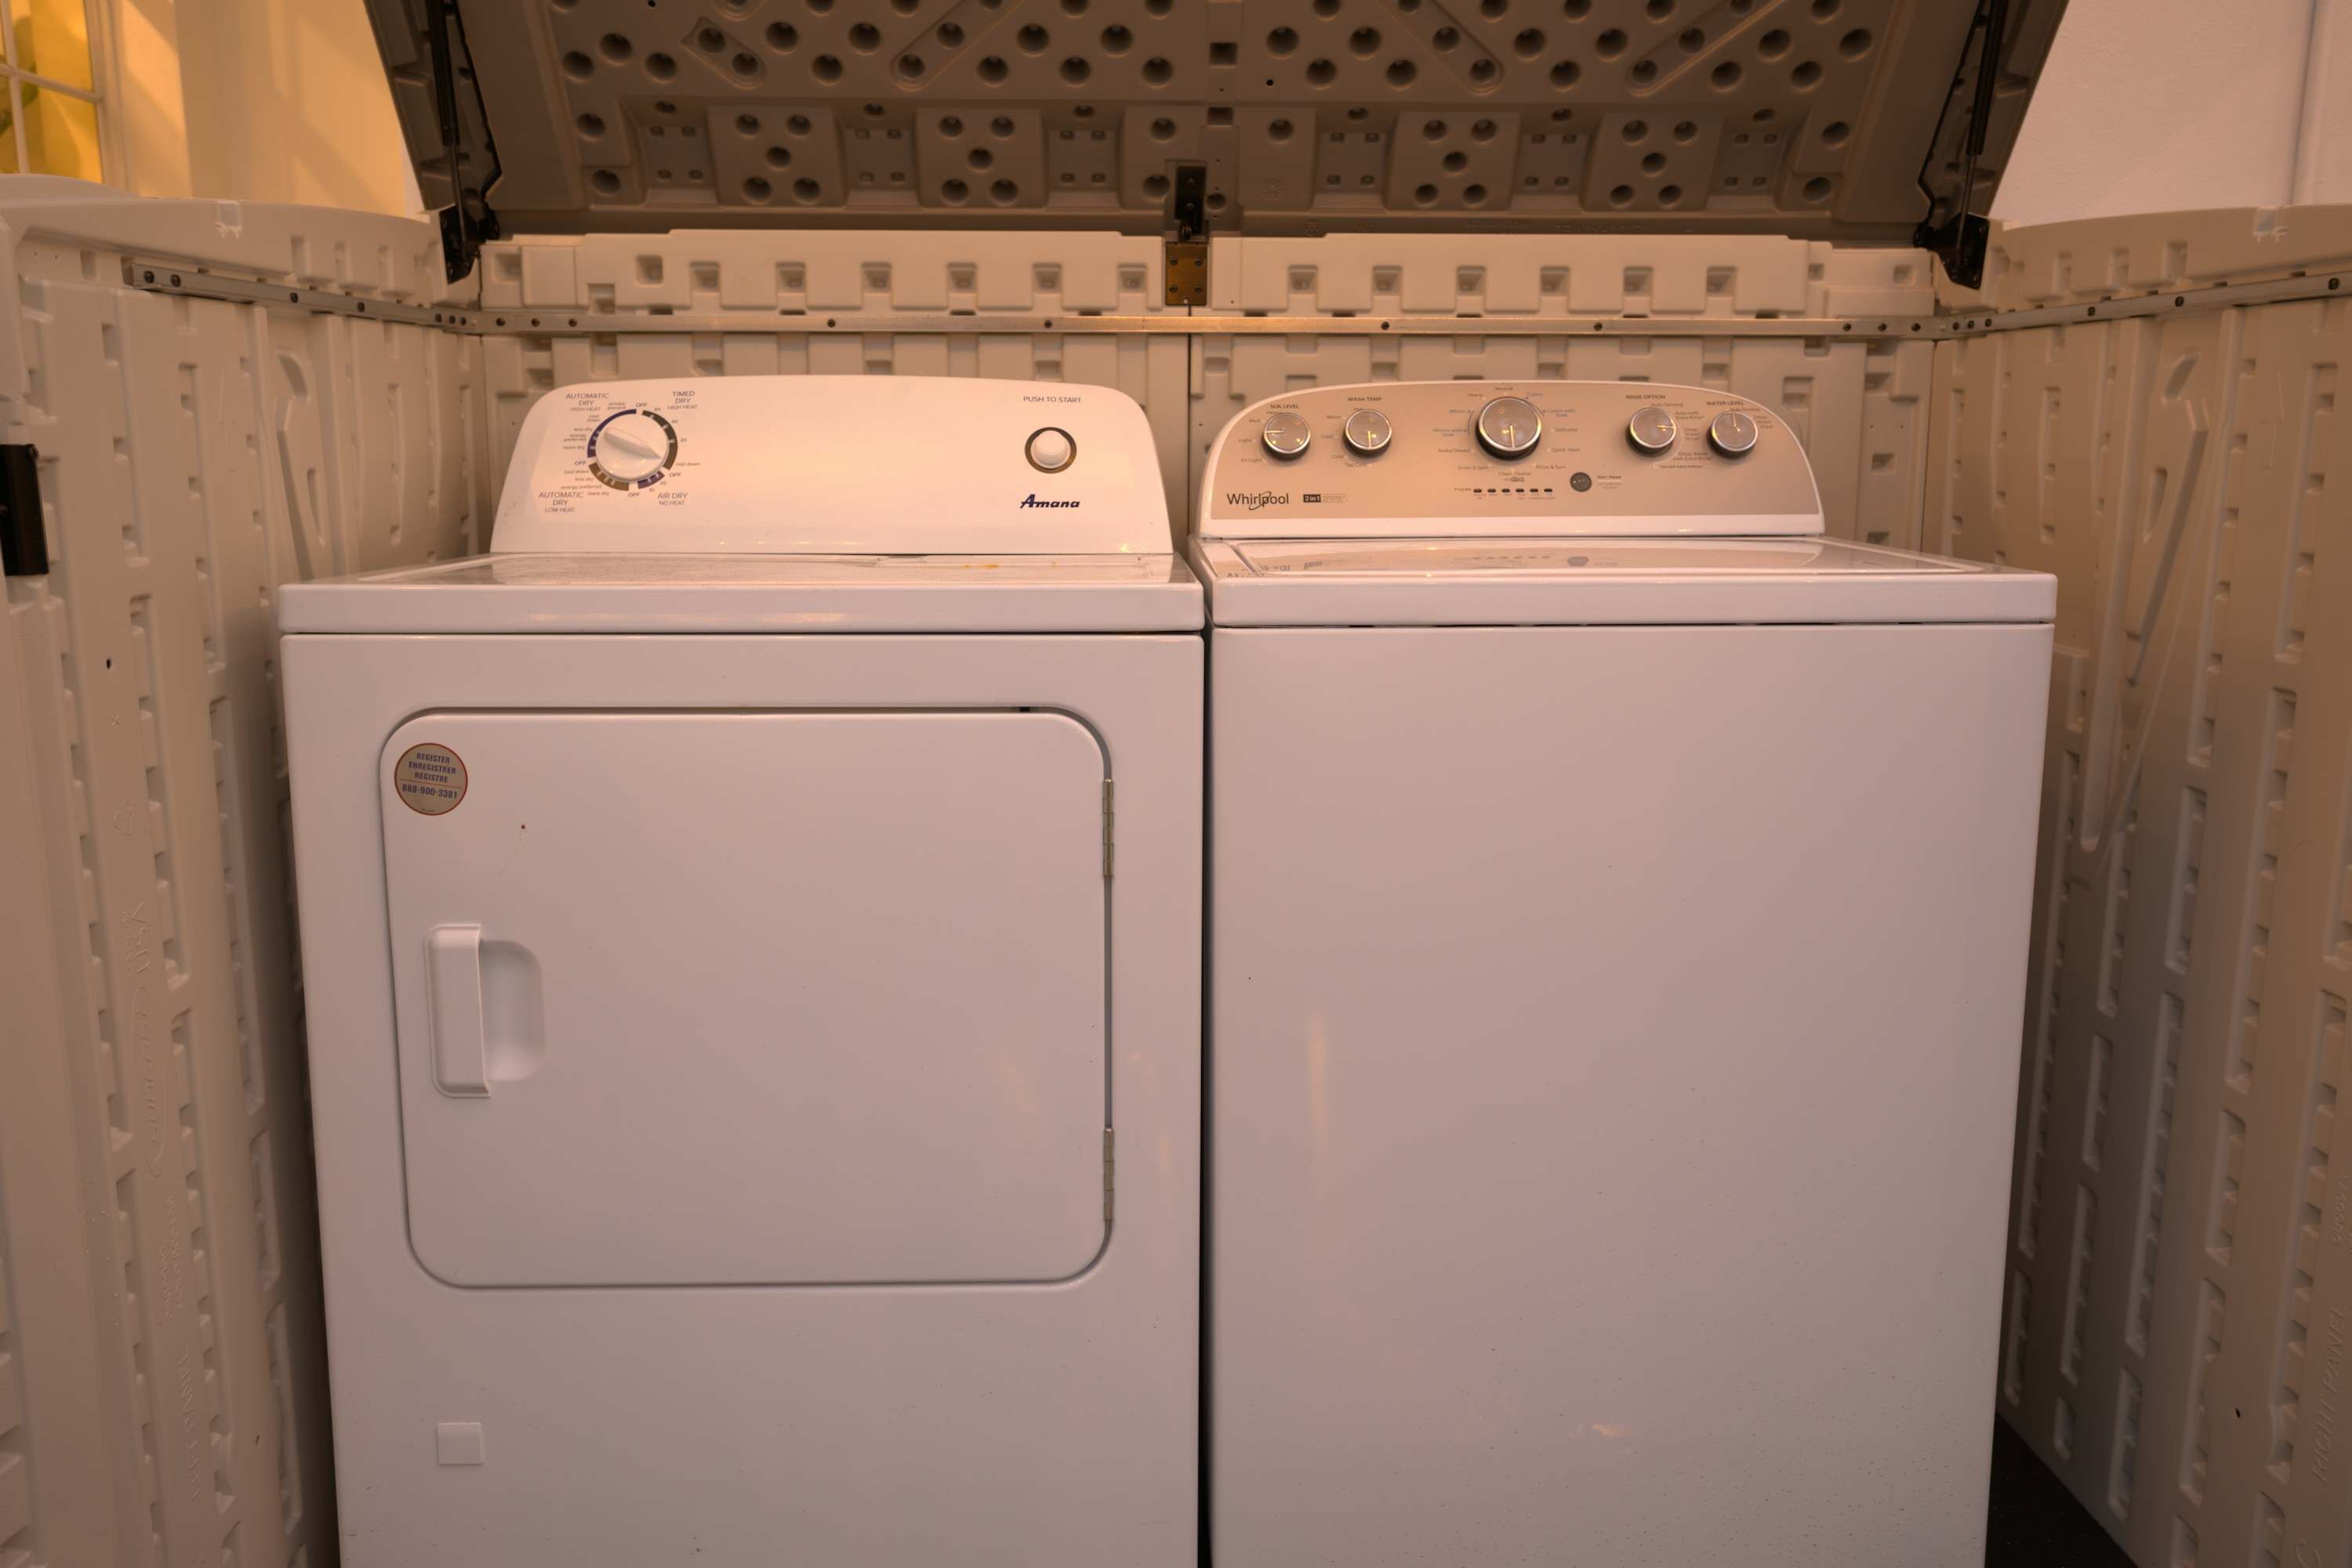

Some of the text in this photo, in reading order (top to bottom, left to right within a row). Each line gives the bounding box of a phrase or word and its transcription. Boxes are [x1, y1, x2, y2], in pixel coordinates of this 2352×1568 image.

[1020, 494, 1080, 509] Amana
[1226, 492, 1289, 510] Whirlpool
[416, 753, 450, 764] REGISTER
[408, 761, 456, 775] ENREGISTRER
[415, 772, 449, 783] REGISTRE
[2310, 1305, 2347, 1482] RIGHT PANEL
